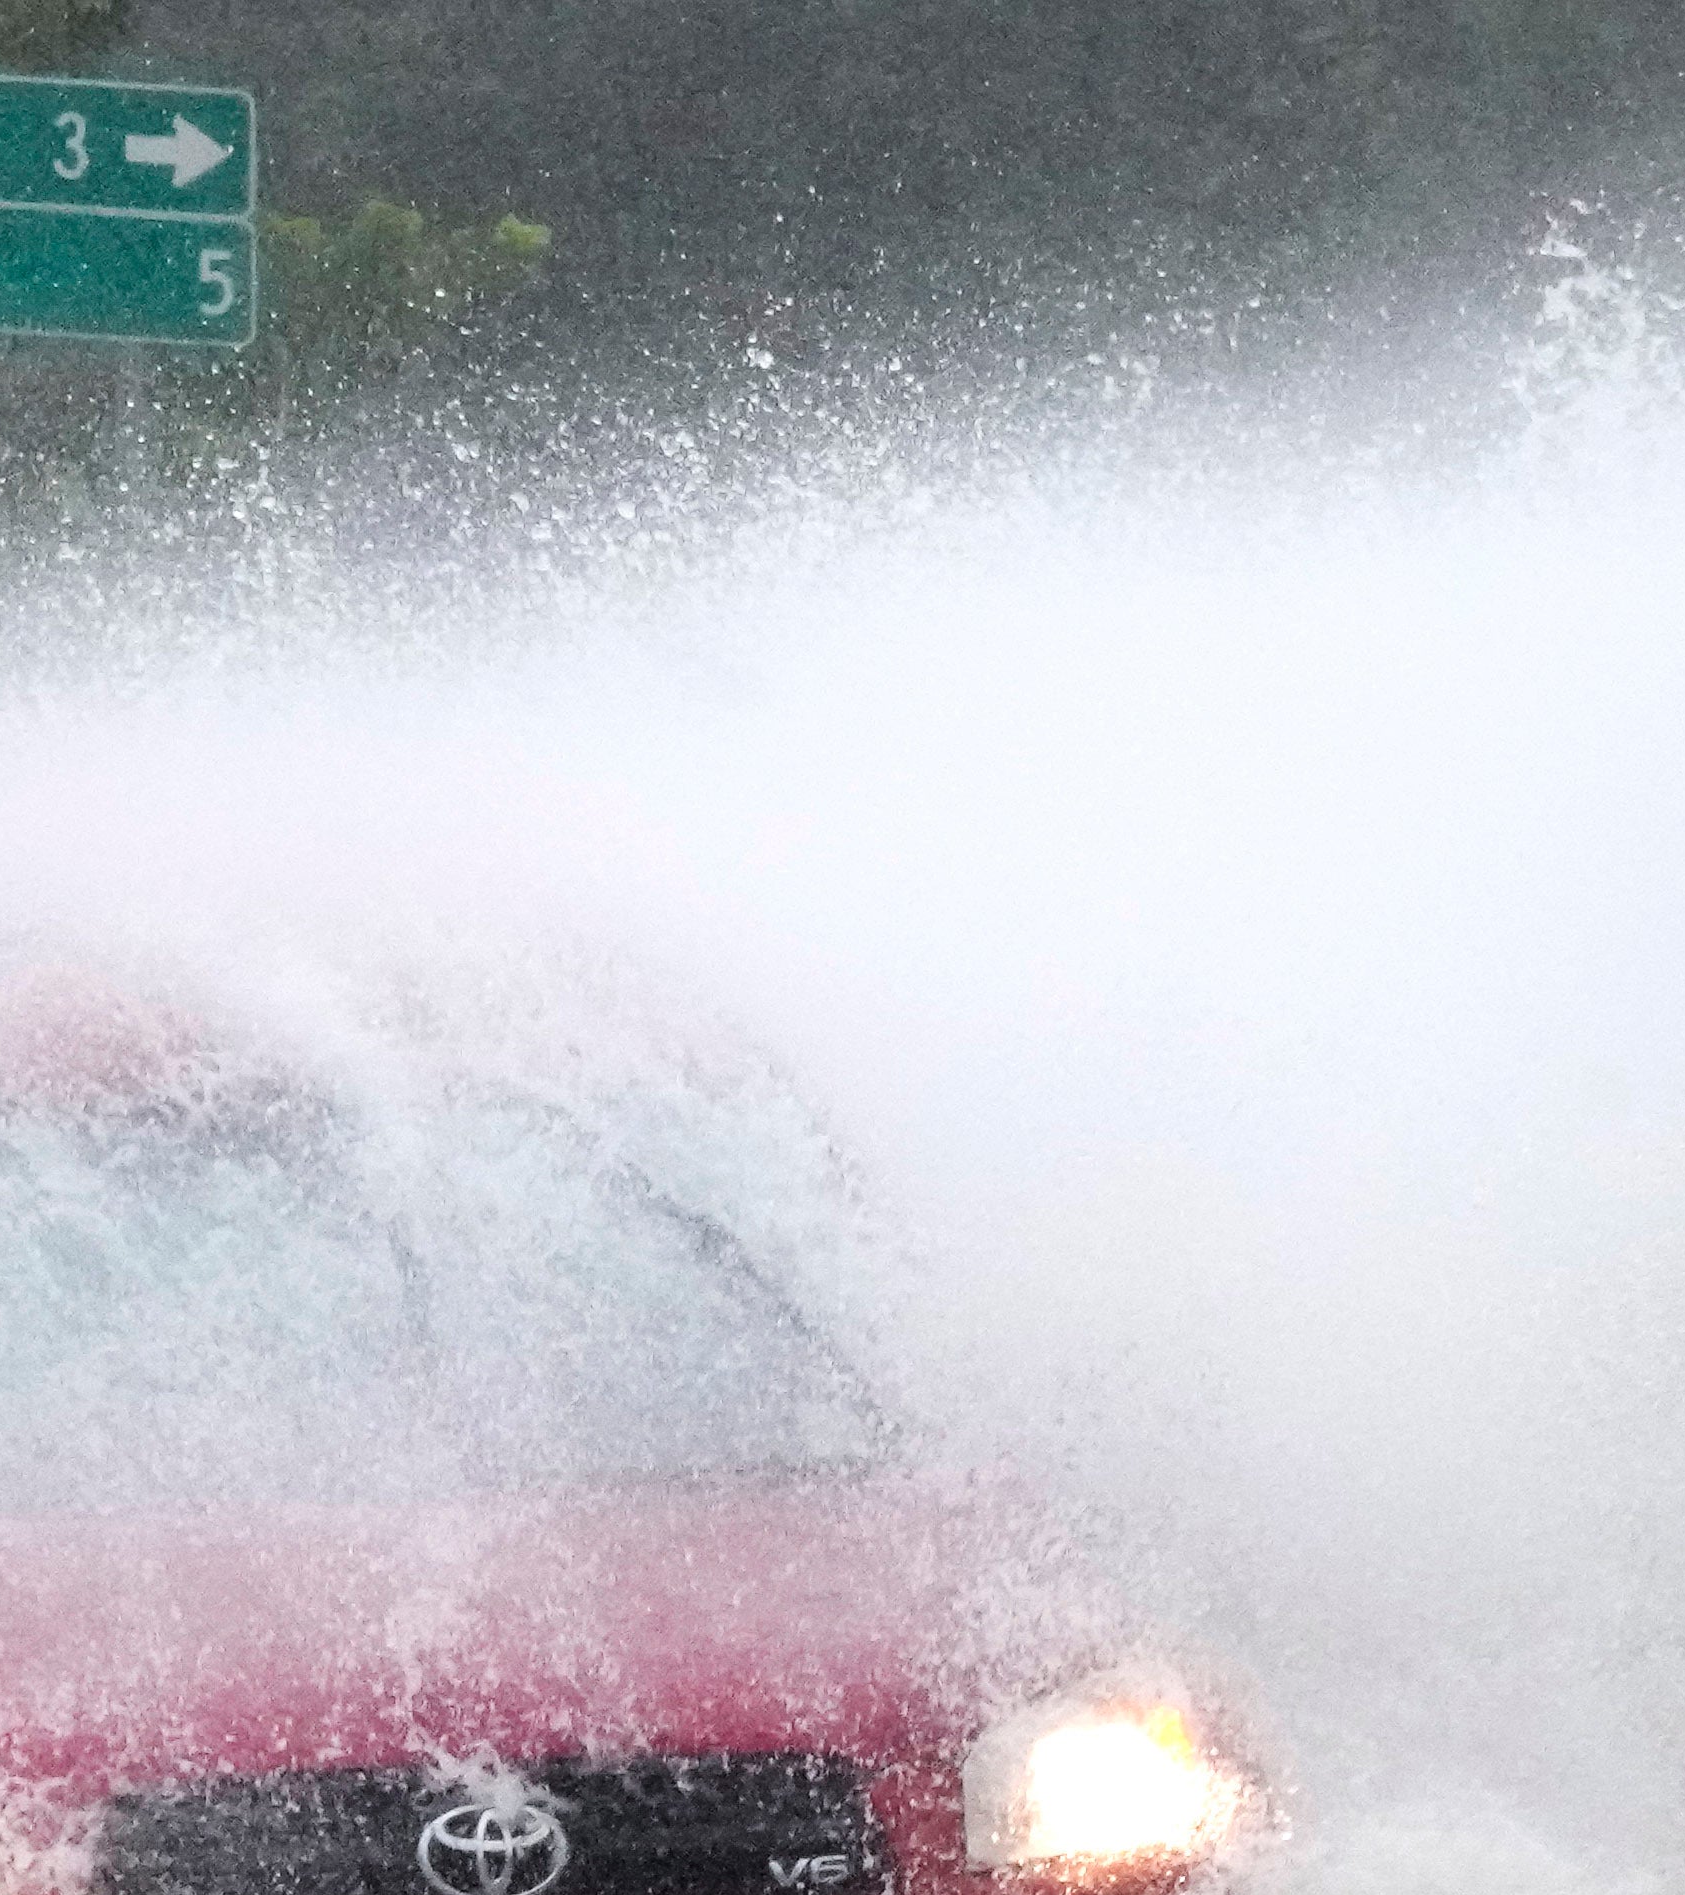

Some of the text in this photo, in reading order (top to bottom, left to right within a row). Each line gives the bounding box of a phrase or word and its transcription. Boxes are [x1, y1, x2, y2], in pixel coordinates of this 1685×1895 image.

[53, 112, 90, 182] 3
[200, 250, 235, 315] 5
[769, 1854, 849, 1887] V6
